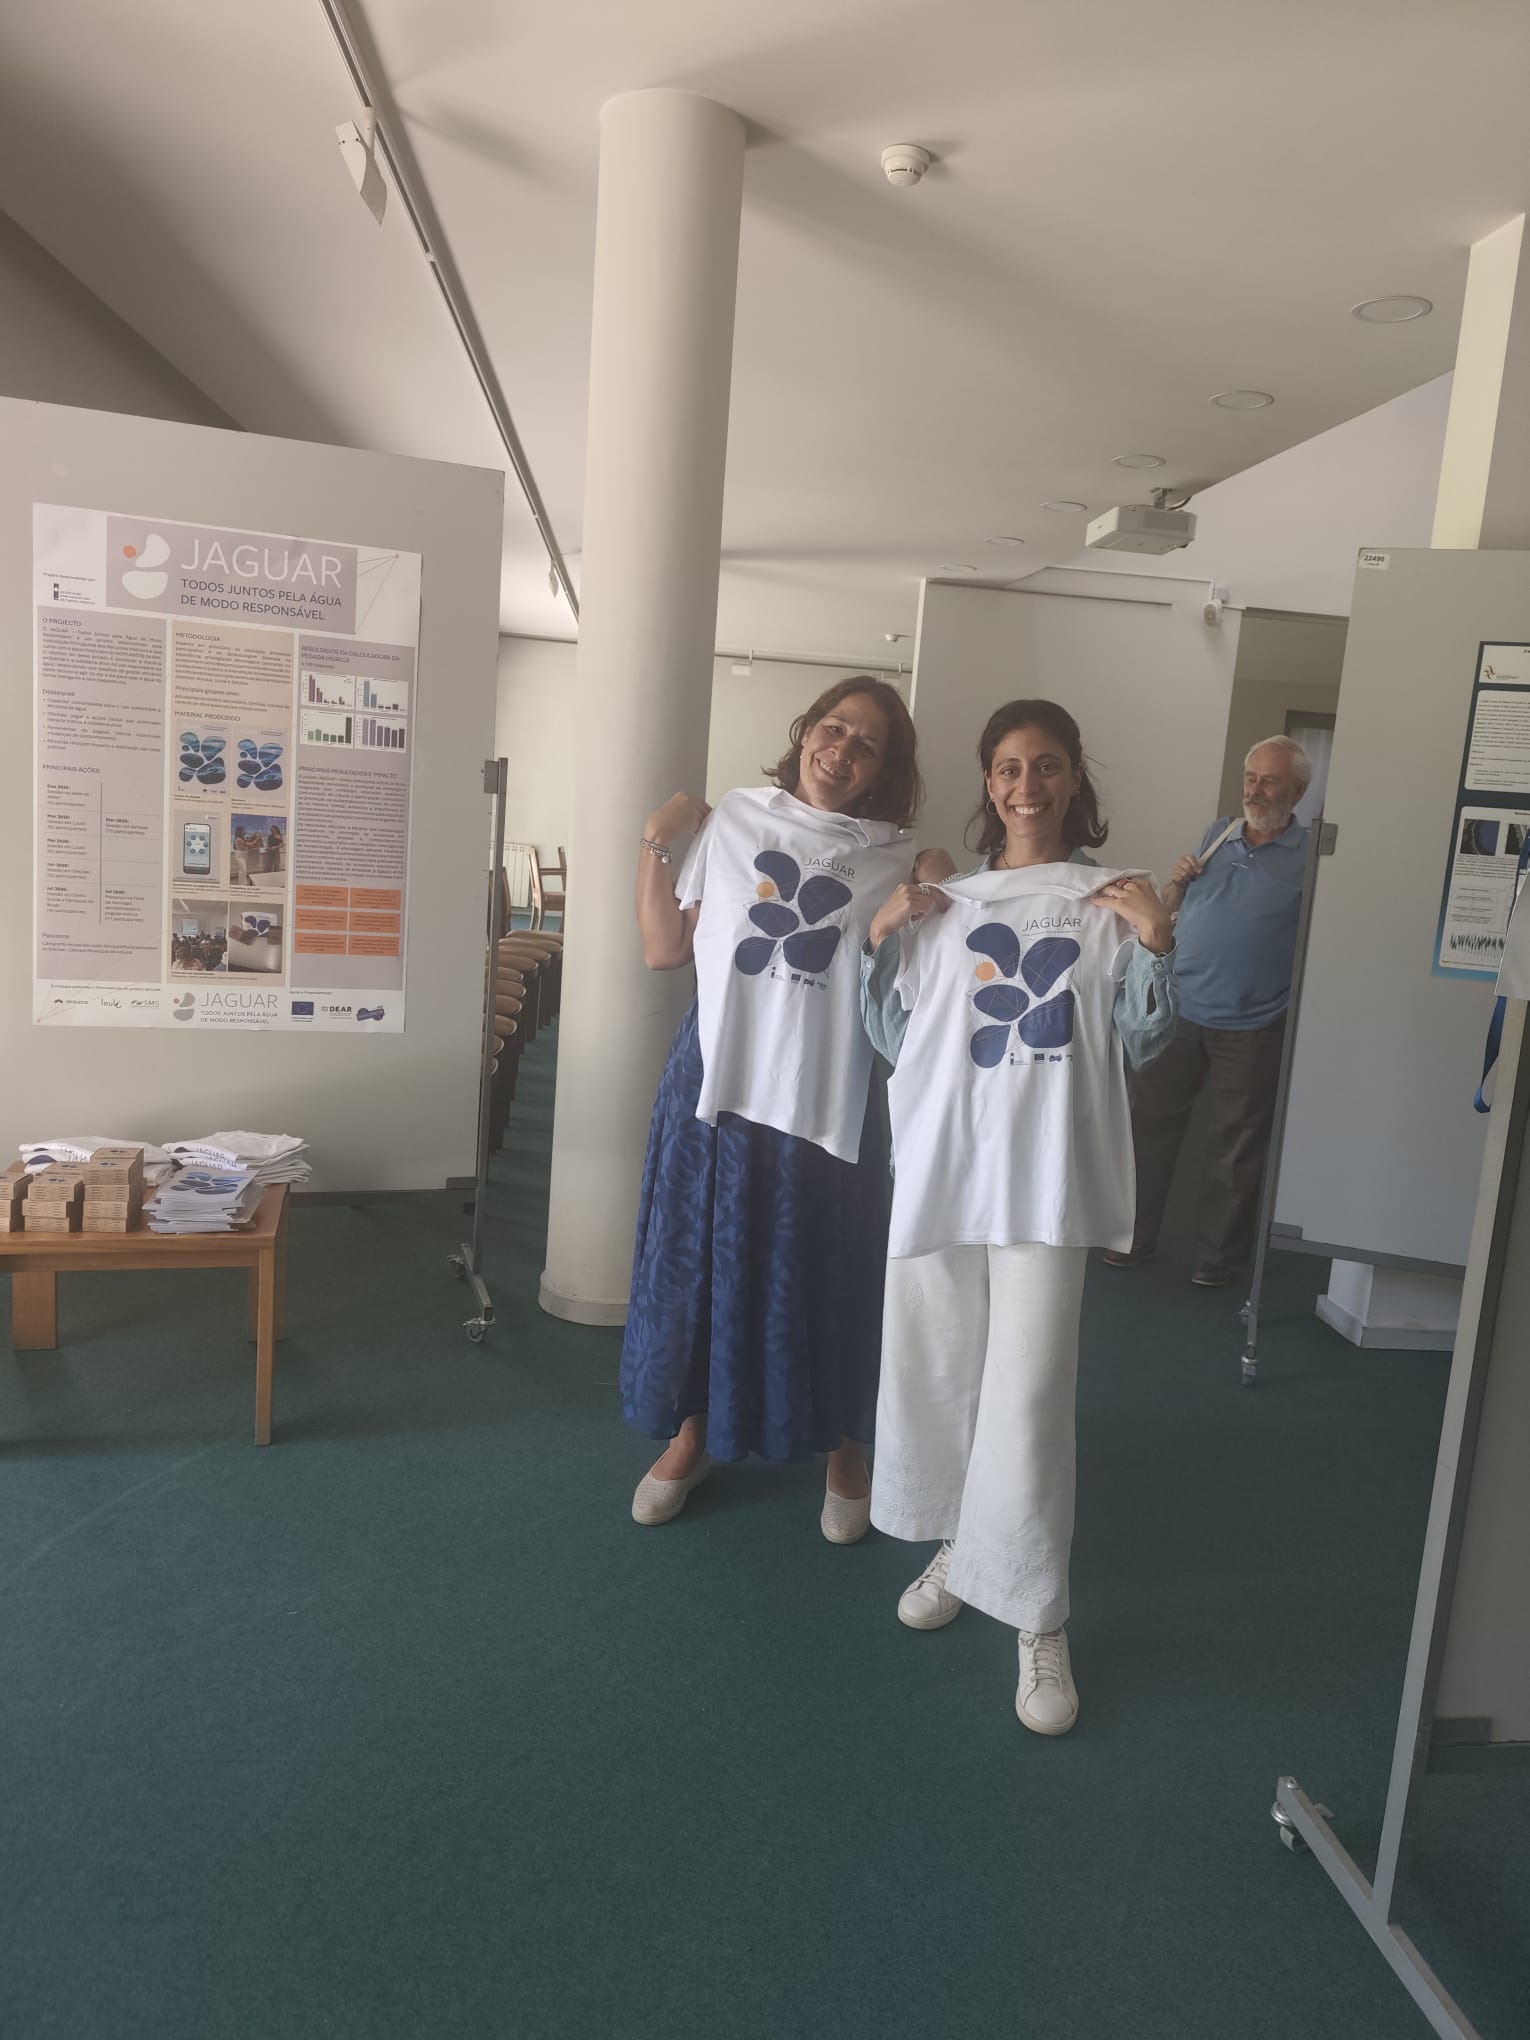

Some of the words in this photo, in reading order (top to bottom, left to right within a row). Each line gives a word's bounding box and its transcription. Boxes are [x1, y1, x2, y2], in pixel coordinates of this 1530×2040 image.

[181, 539, 342, 588] JAGUAR
[180, 578, 224, 593] TODOS
[227, 584, 275, 599] JUNTOS
[278, 590, 306, 602] PELA
[309, 592, 342, 607] ÁGUA
[180, 594, 197, 606] DE
[200, 597, 239, 610] MODO
[242, 602, 325, 620] RESPONSÁVEL
[804, 857, 855, 879] JAGUAR
[1021, 917, 1082, 932] JAGUAR
[200, 992, 278, 1009] JAGUAR
